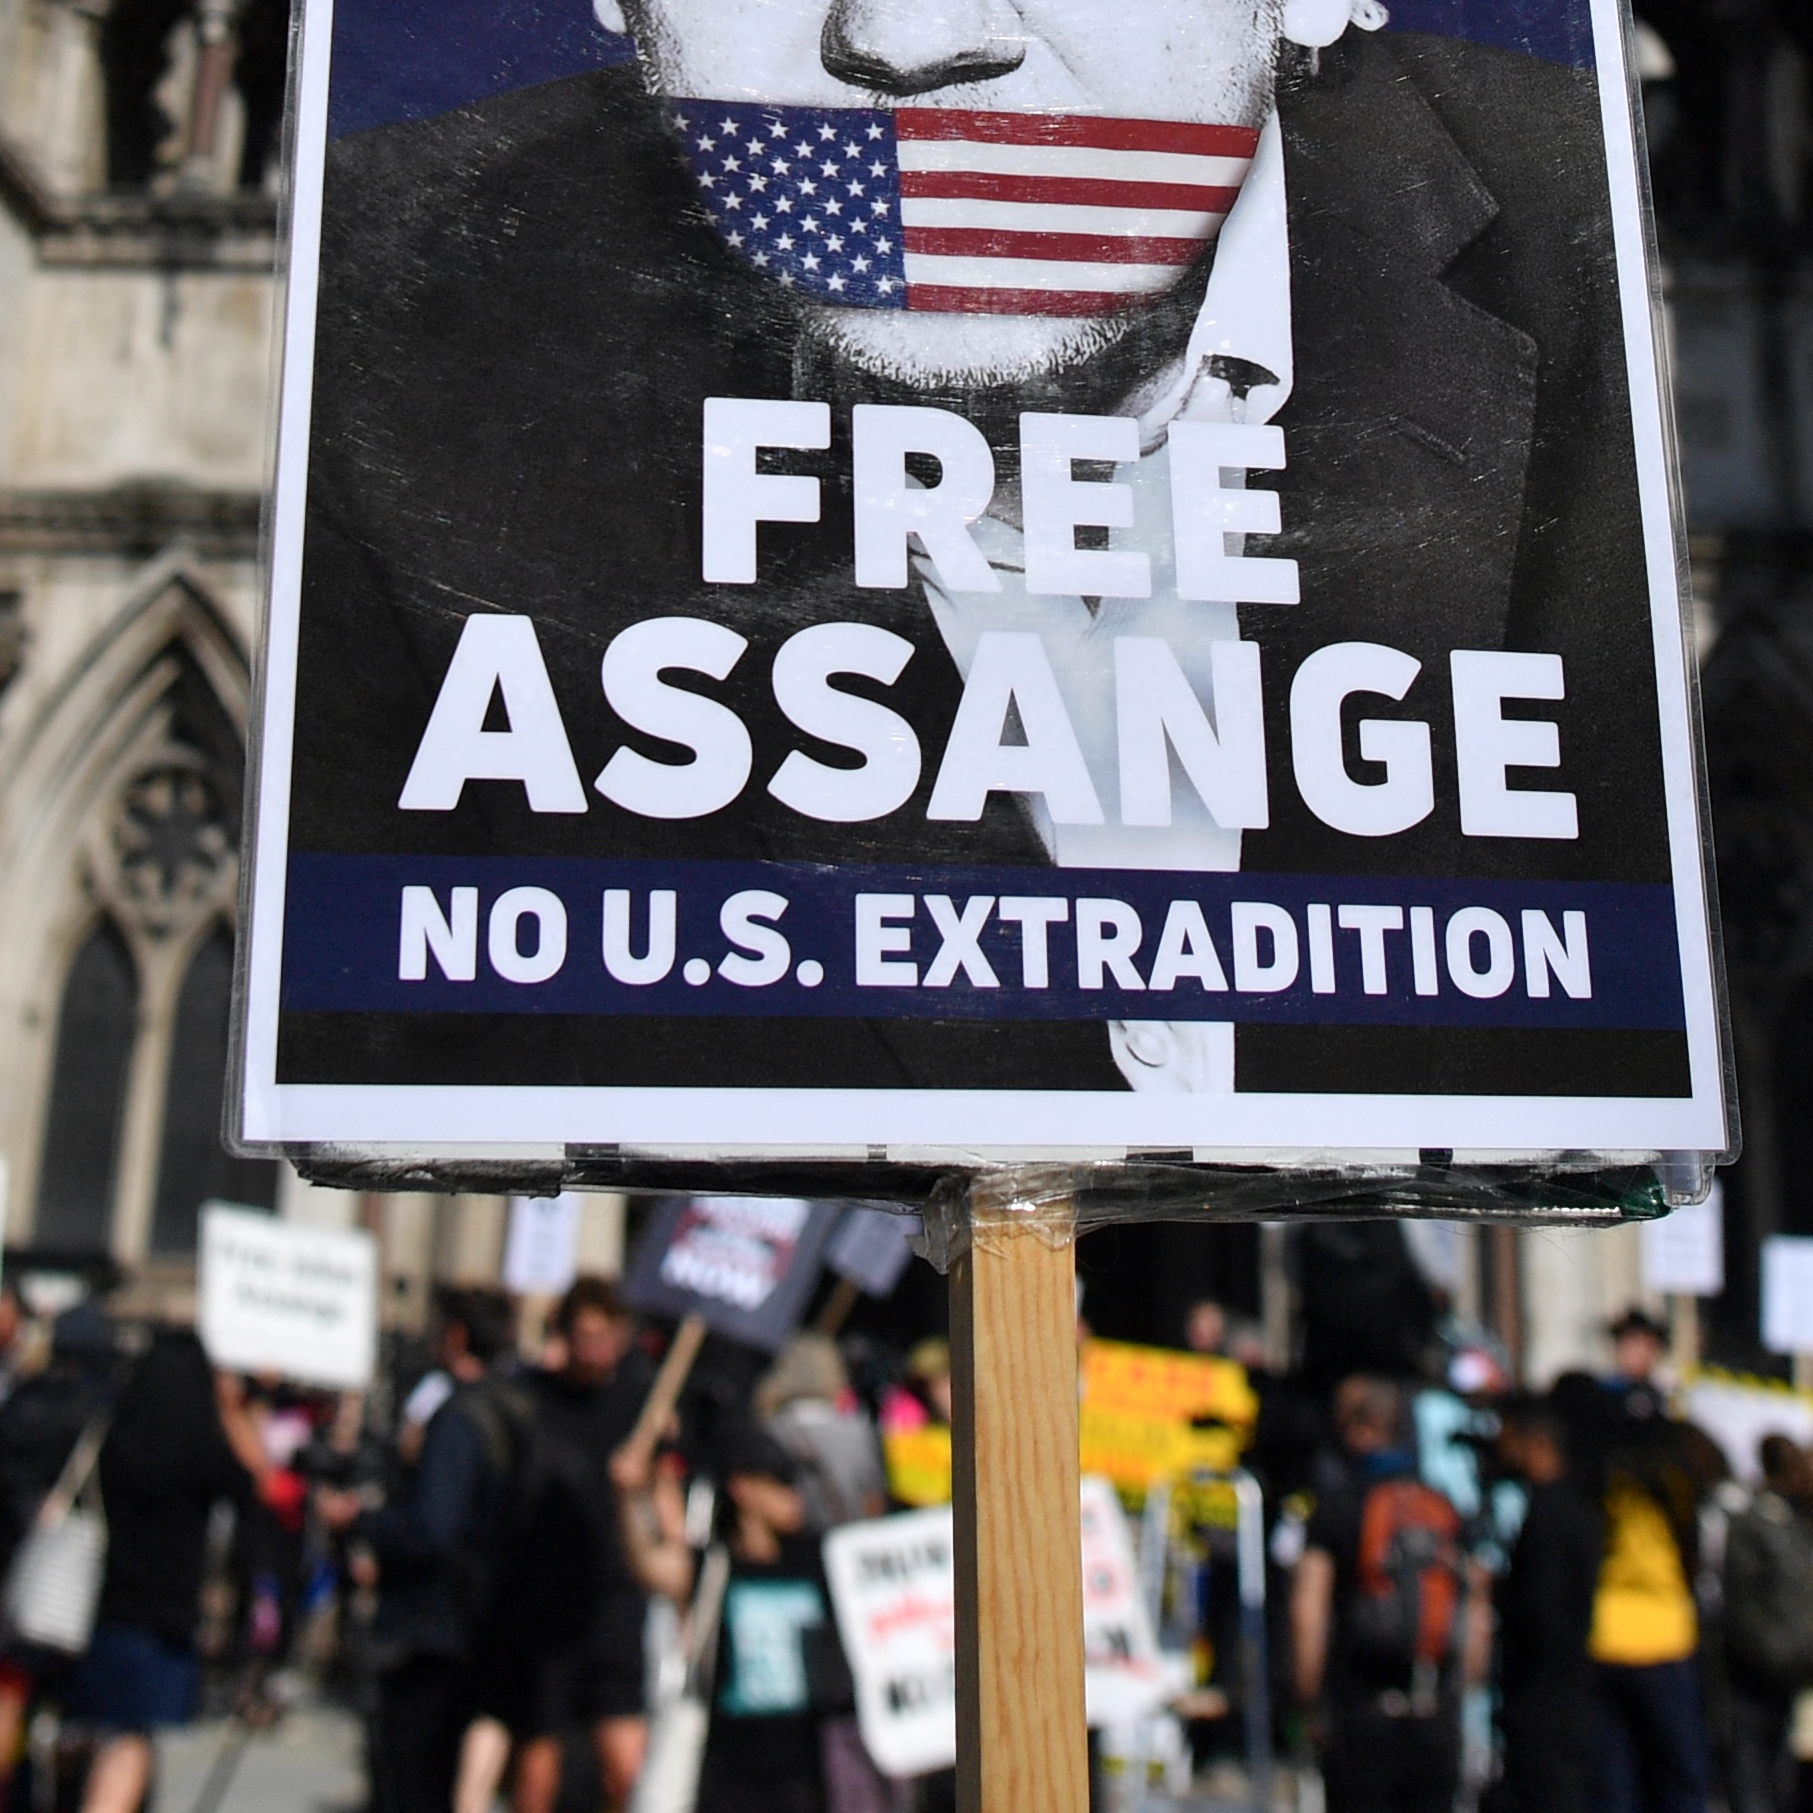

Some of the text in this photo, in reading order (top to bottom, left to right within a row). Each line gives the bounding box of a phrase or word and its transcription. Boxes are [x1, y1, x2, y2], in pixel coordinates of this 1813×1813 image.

[702, 396, 1299, 604] FREE
[397, 613, 1580, 840] ASSANGE
[397, 884, 1593, 999] NO U.S. EXTRADITION
